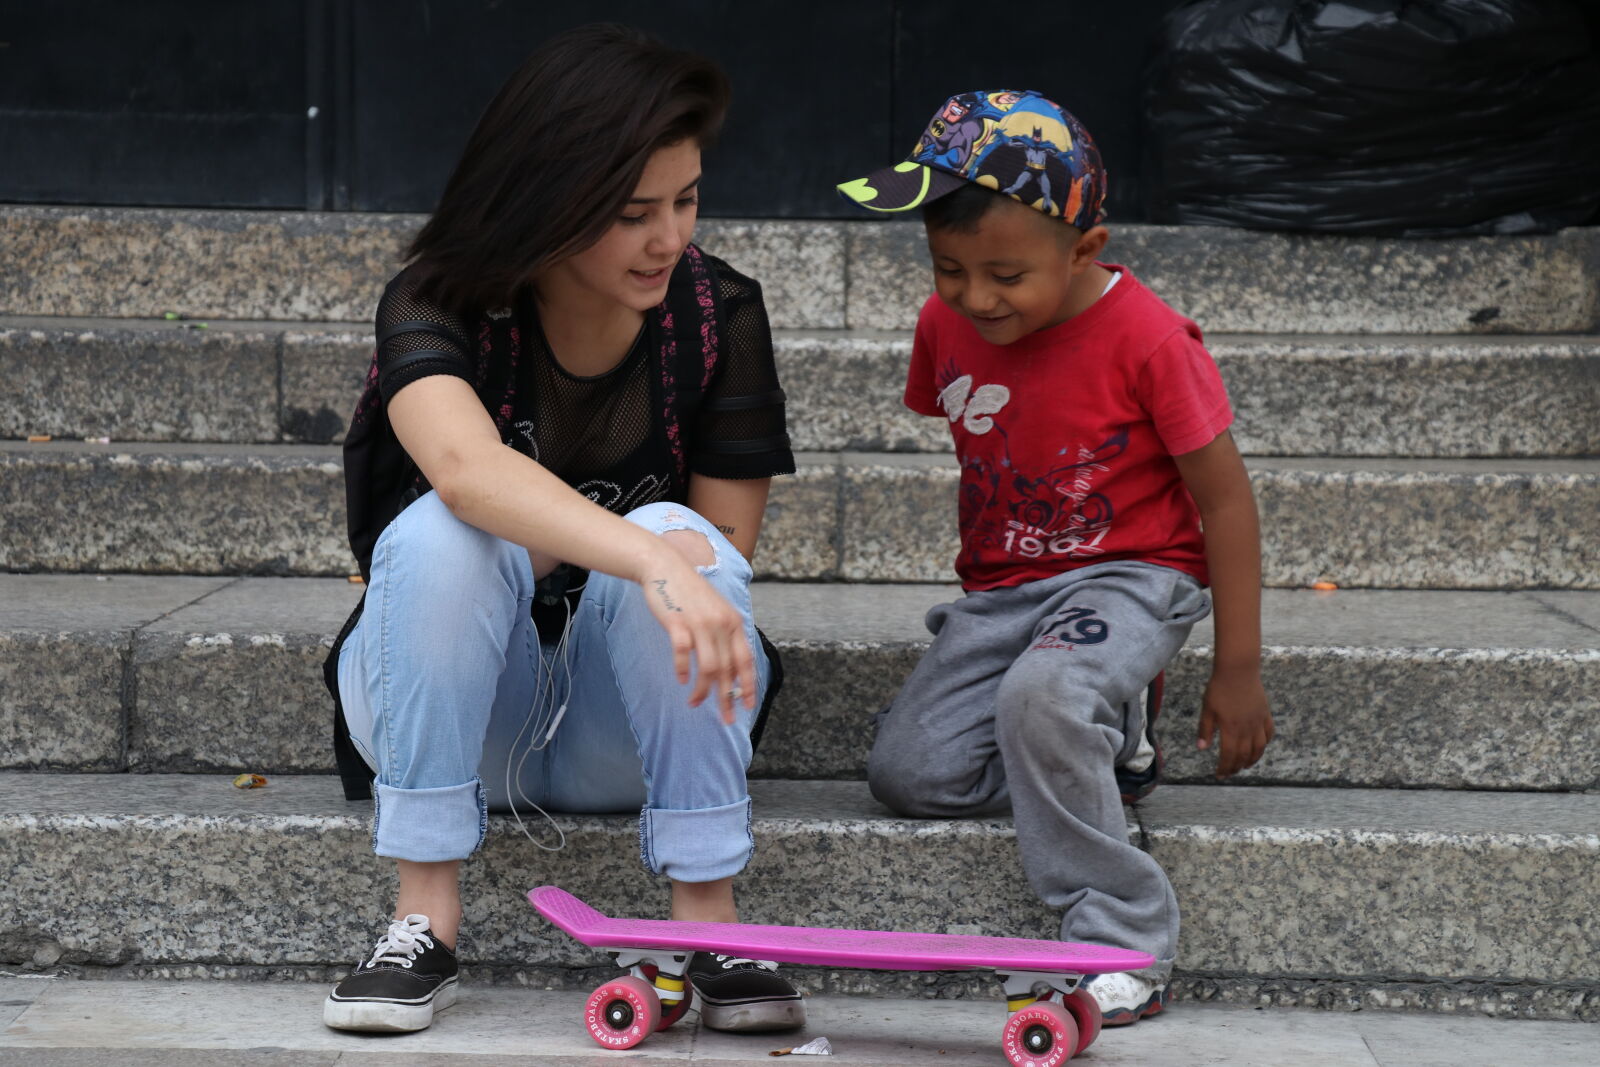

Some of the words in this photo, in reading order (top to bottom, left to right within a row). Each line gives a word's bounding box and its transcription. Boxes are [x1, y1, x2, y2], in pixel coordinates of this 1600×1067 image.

[1004, 526, 1111, 558] 1967
[1042, 606, 1108, 645] 79
[588, 989, 629, 1046] SKATEBOARDS
[628, 994, 644, 1020] FISH
